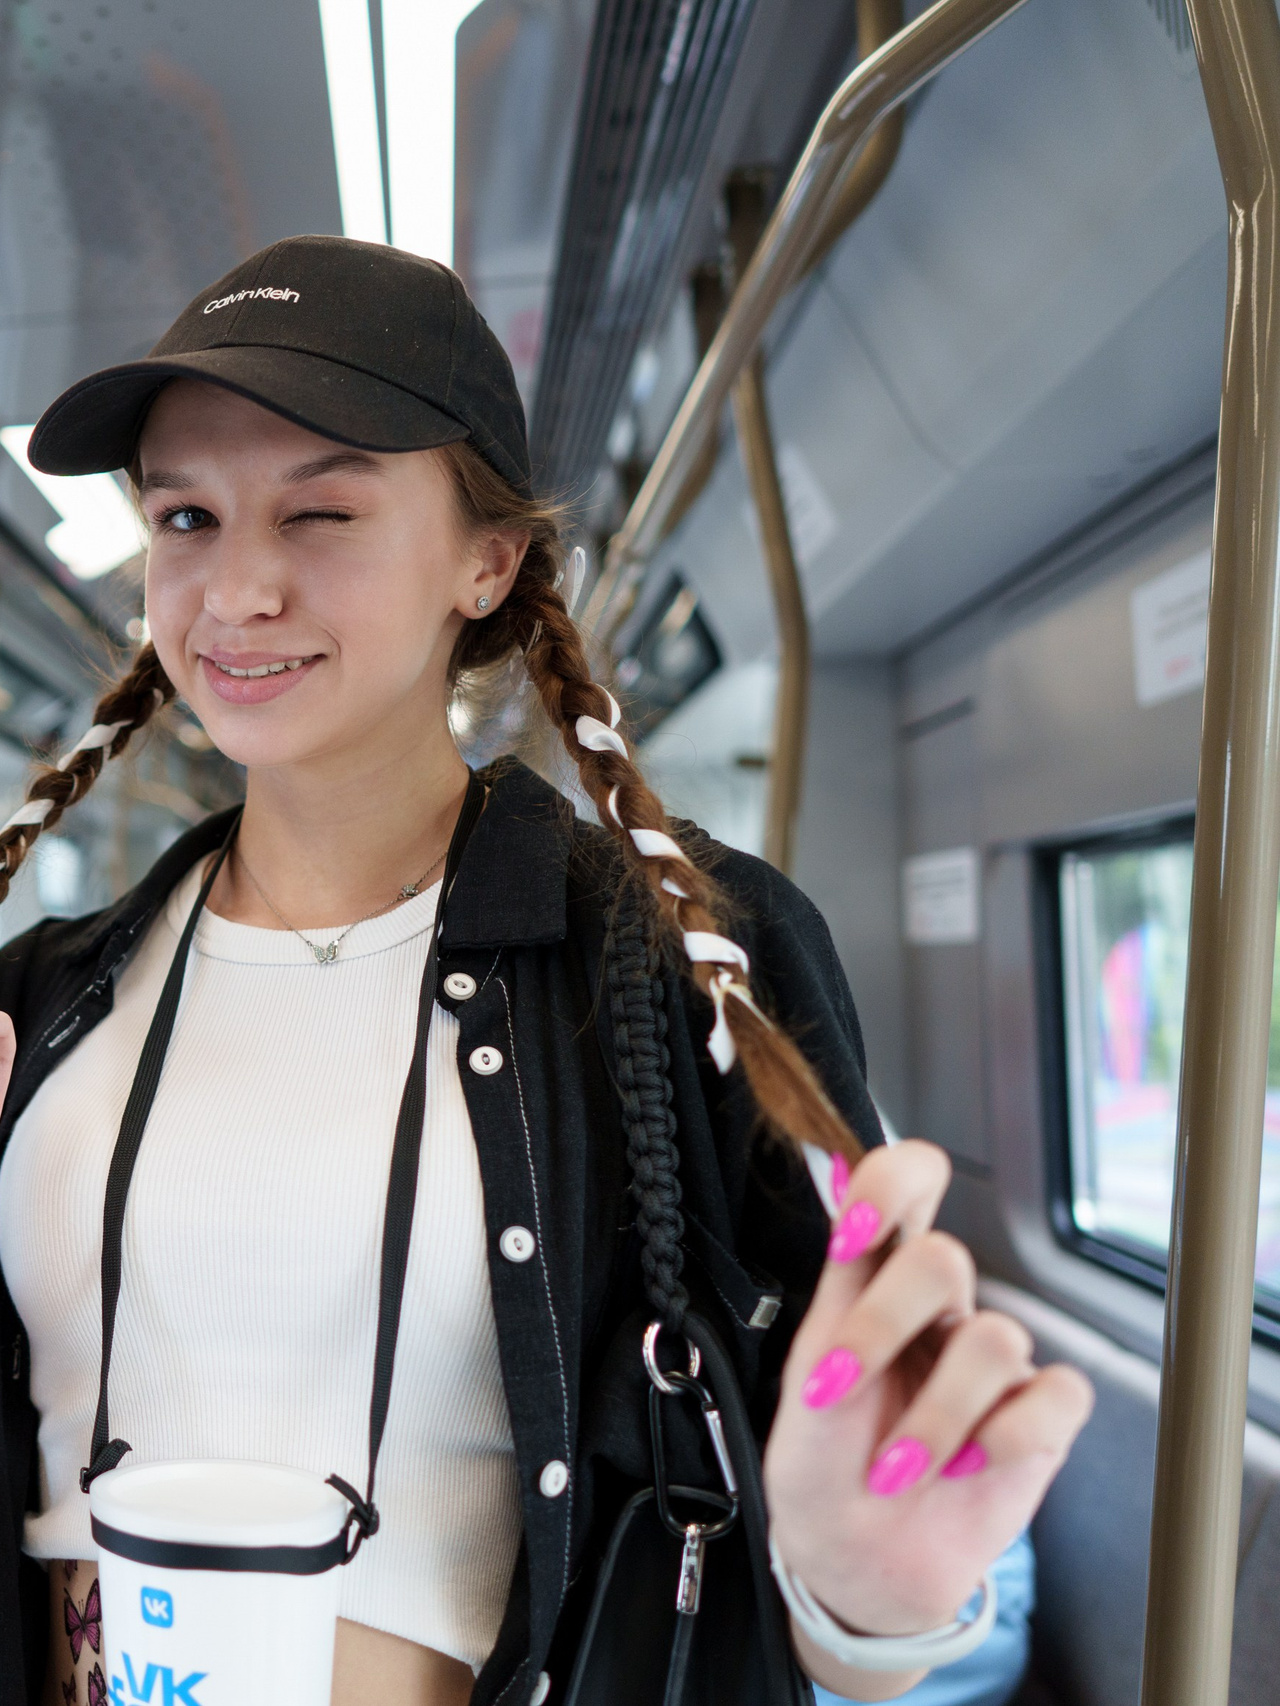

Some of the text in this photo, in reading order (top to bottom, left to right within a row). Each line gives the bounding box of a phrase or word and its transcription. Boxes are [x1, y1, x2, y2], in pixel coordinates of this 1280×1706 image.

[203, 286, 300, 314] Calvin Klein
[144, 1596, 169, 1620] VK
[121, 1650, 210, 1706] VK
